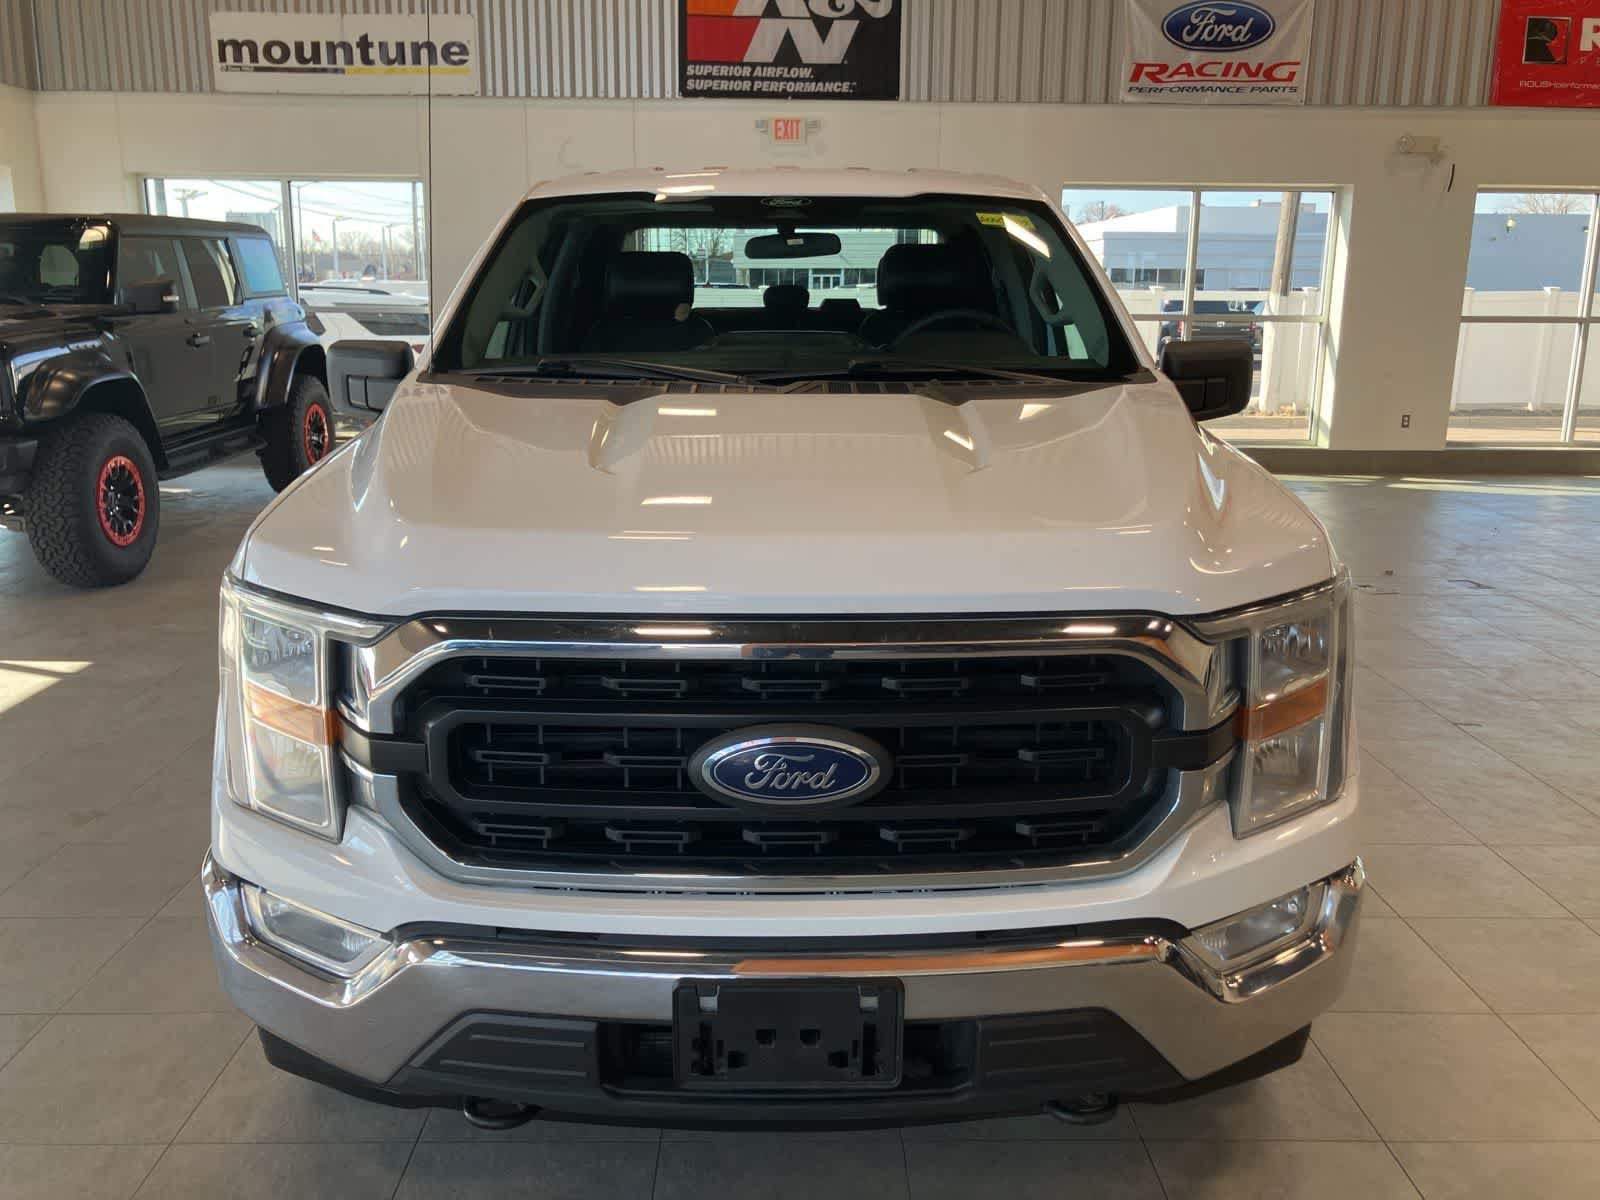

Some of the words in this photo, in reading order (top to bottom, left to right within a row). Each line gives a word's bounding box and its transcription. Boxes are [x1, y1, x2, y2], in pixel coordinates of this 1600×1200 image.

[1182, 7, 1255, 42] Ford
[217, 33, 470, 66] mountune
[686, 65, 751, 77] SUPERIOR
[753, 66, 814, 79] AIRFLOW.
[1129, 61, 1301, 83] RACING
[686, 79, 751, 91] SUPERIOR
[1128, 86, 1246, 94] PERFORMANCE
[774, 119, 801, 141] EXIT
[744, 753, 838, 790] Ford
